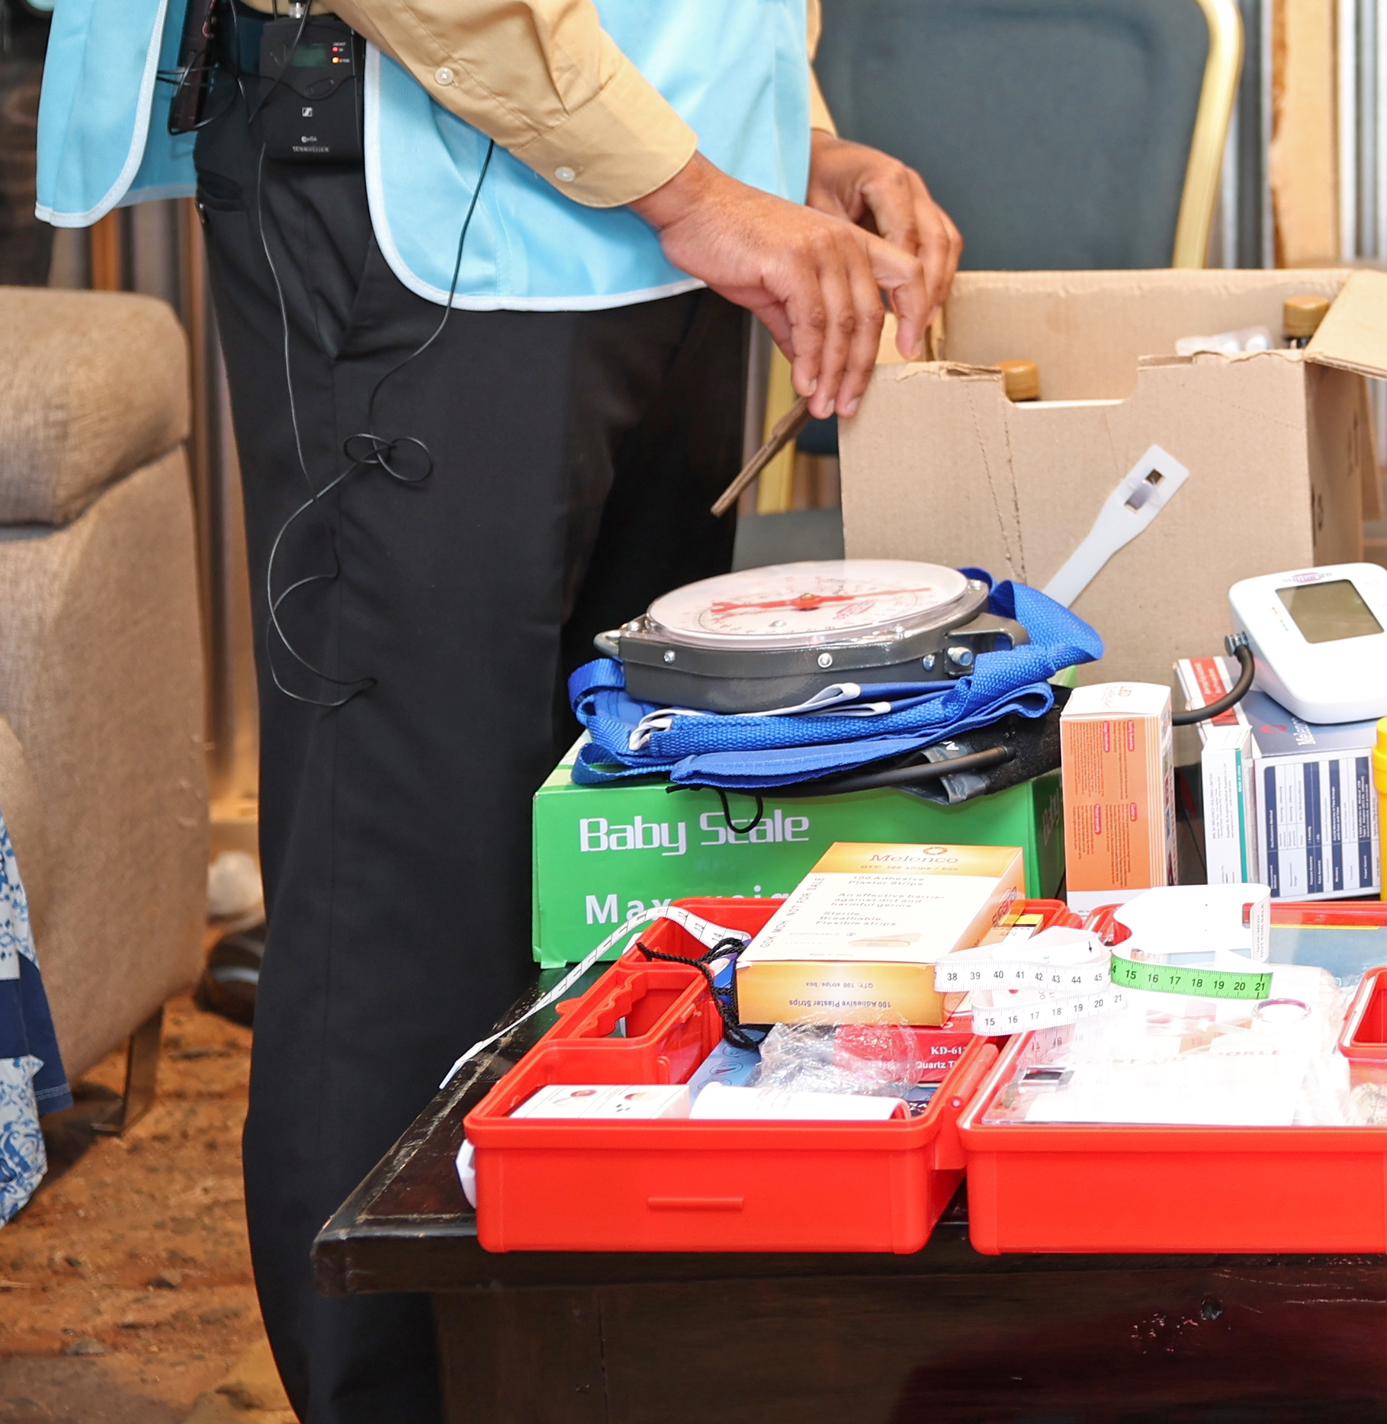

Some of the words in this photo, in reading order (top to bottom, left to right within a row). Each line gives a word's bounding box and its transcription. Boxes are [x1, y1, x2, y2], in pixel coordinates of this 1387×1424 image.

[579, 816, 687, 856] Baby
[700, 809, 810, 845] Scale
[869, 854, 960, 864] Melenco
[947, 972, 957, 981] 38
[970, 971, 981, 980] 39
[993, 970, 1004, 979] 40
[1015, 971, 1025, 979] 41
[1034, 973, 1044, 981] 42
[1051, 975, 1060, 983] 43
[1071, 976, 1081, 984] 44
[1093, 973, 1103, 982] 45
[1125, 969, 1137, 979] 15
[1148, 974, 1159, 983] 16
[1169, 976, 1181, 985] 17
[1191, 978, 1203, 988] 18
[1213, 980, 1225, 990] 19
[1233, 981, 1246, 991] 20
[1254, 982, 1265, 991] 21
[985, 1017, 995, 1026] 15
[1008, 1015, 1018, 1024] 16
[1030, 1011, 1040, 1020] 17
[1052, 1007, 1062, 1016] 18
[1074, 1003, 1083, 1012] 19
[1094, 999, 1104, 1008] 20
[1114, 994, 1123, 1003] 21
